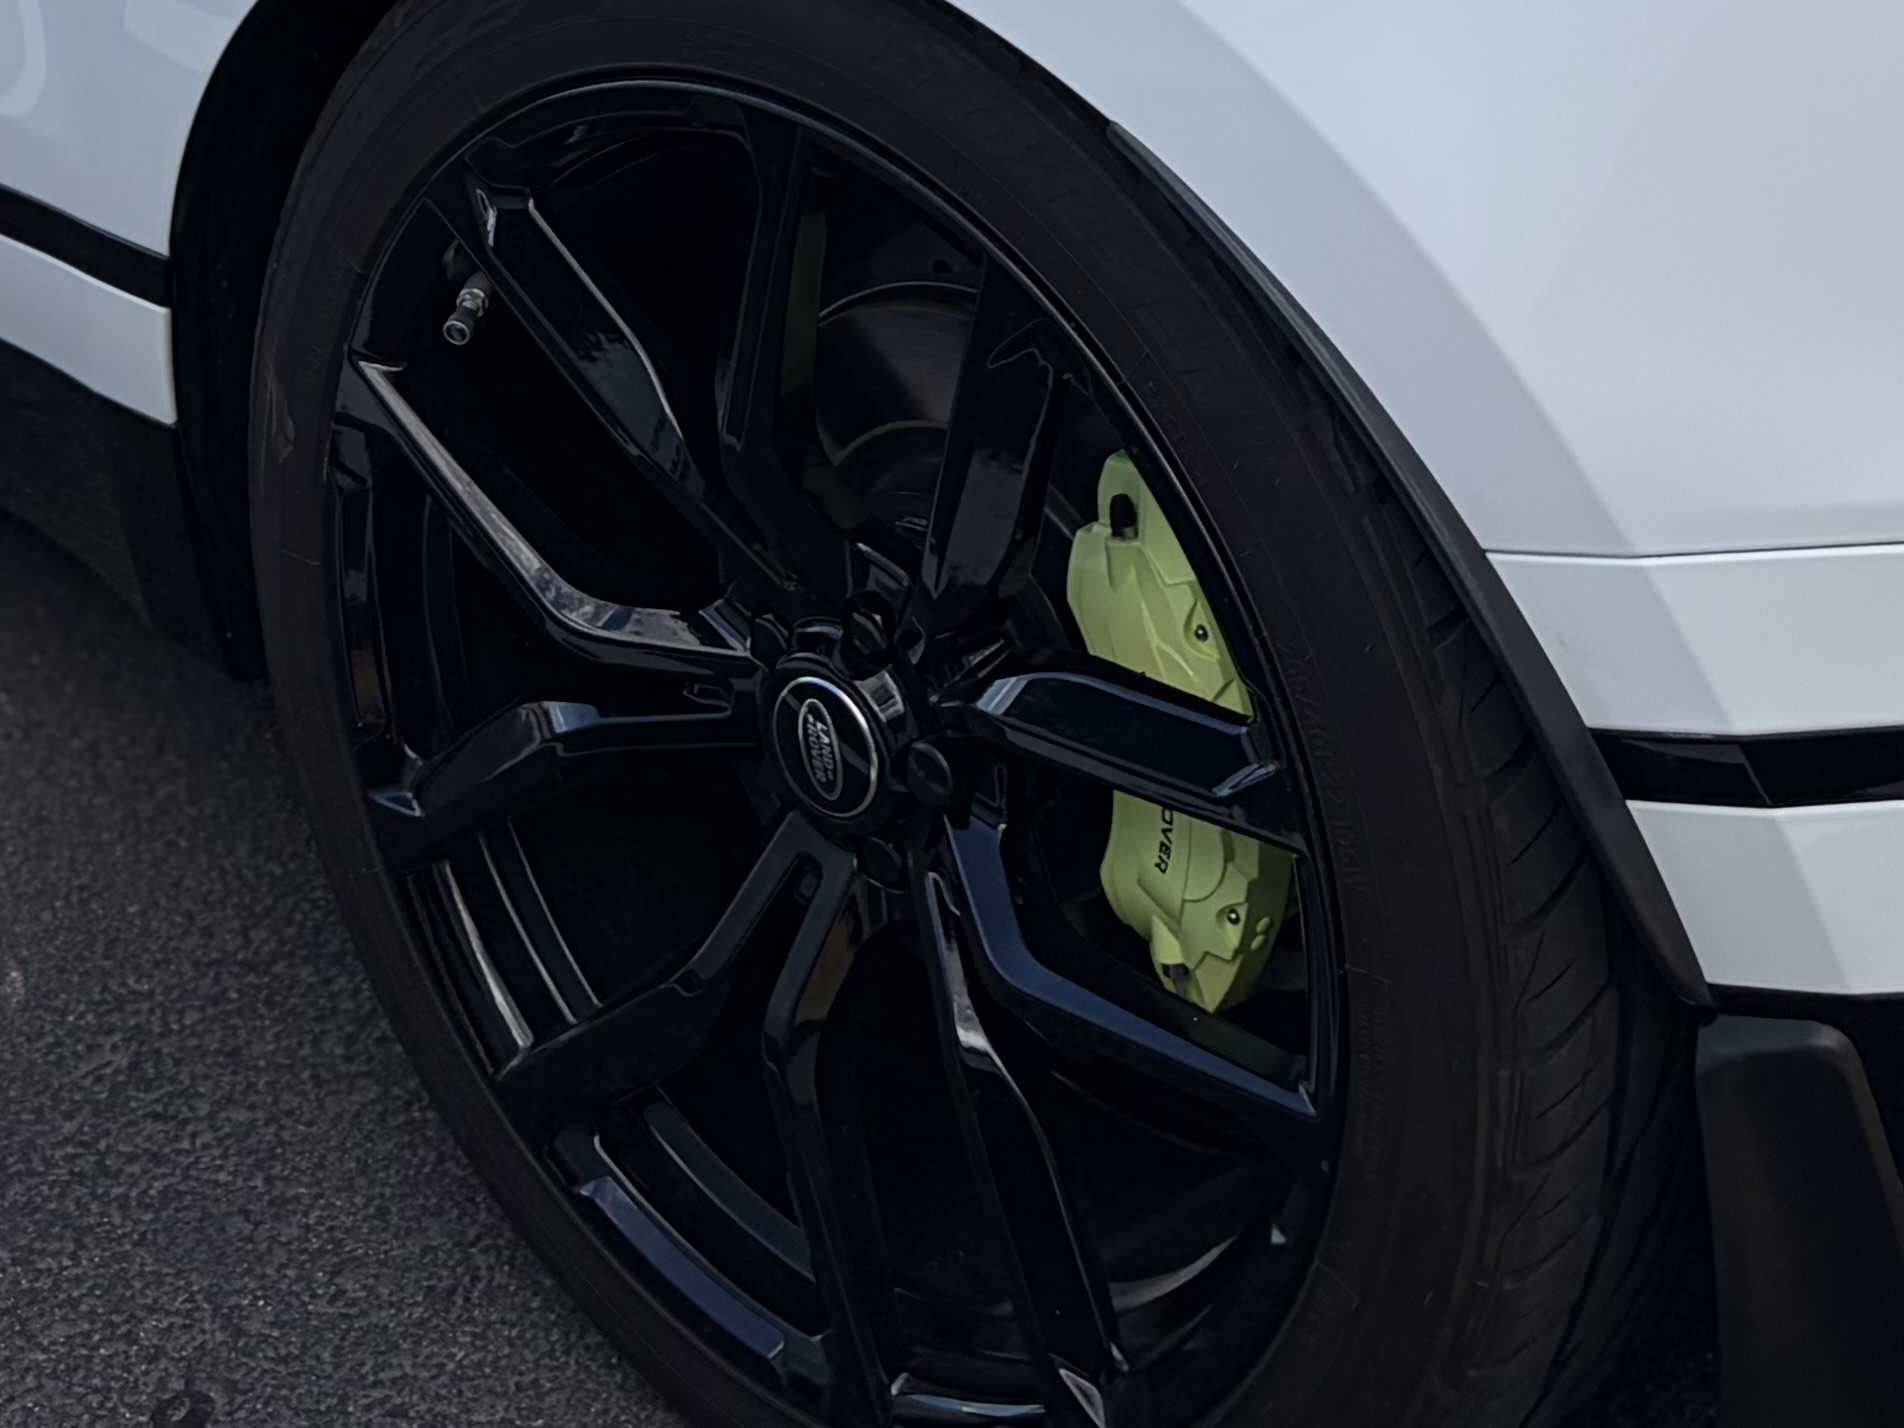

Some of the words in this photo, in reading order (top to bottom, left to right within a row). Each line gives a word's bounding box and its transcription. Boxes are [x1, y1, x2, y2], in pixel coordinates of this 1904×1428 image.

[806, 722, 827, 784] ROVER
[816, 719, 834, 771] LAND
[1154, 807, 1175, 875] OVER
